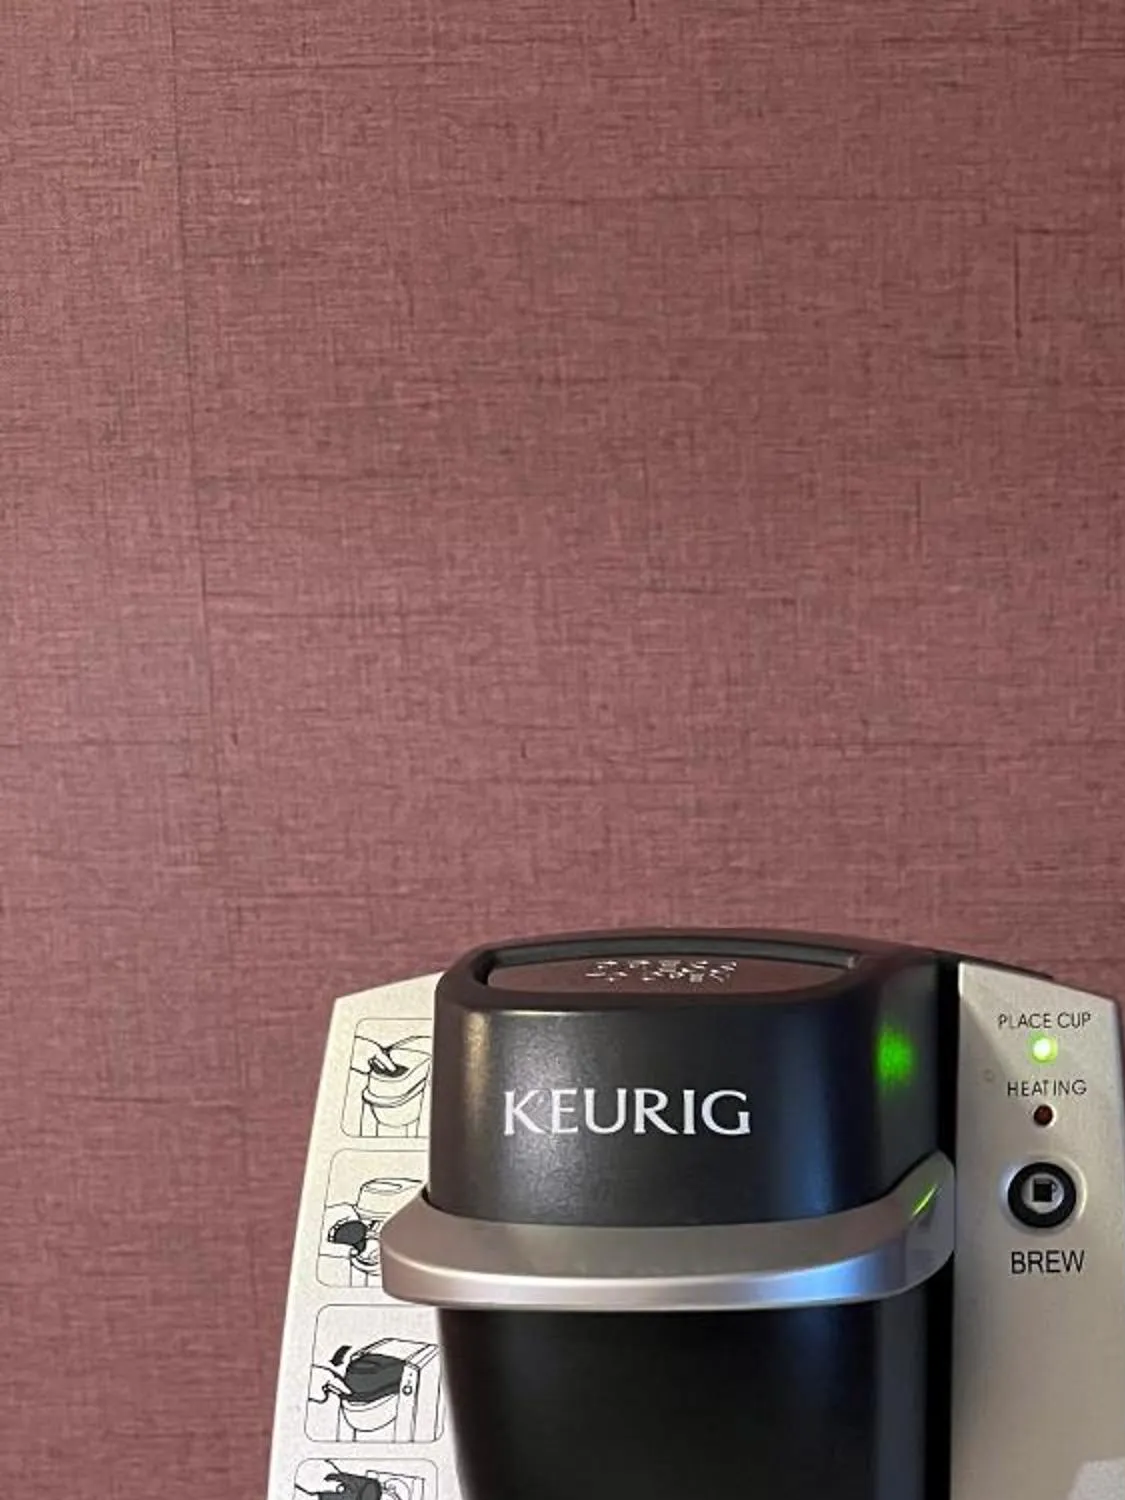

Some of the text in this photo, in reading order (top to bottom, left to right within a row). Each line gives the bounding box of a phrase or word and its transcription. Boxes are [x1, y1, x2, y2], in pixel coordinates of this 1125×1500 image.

[997, 1011, 1092, 1029] PLACE CUP
[1006, 1078, 1088, 1097] HEATING
[503, 1087, 752, 1137] KEURIG
[1010, 1249, 1086, 1275] BREW
